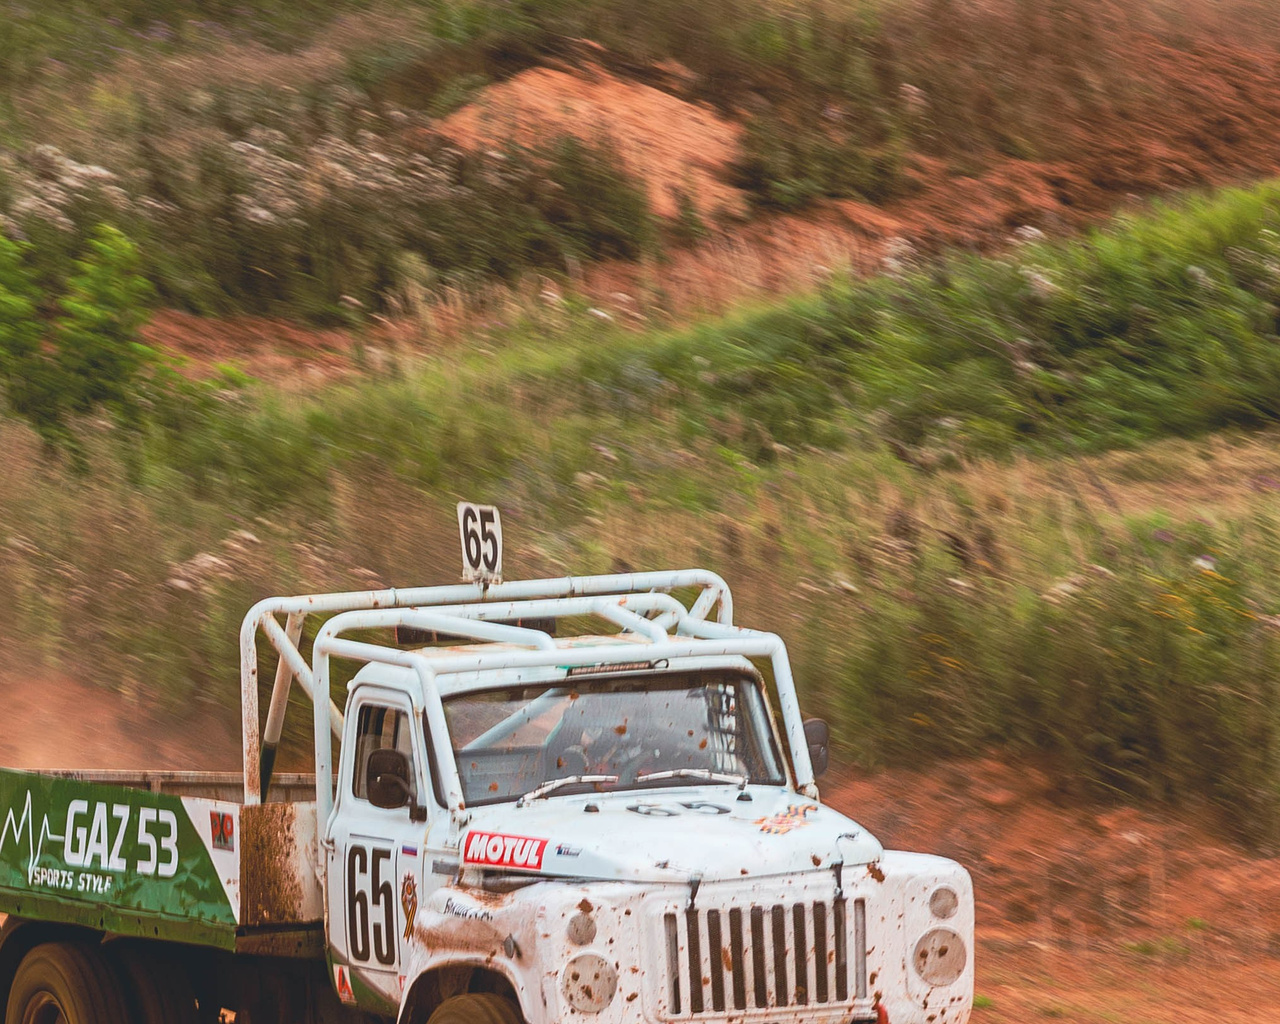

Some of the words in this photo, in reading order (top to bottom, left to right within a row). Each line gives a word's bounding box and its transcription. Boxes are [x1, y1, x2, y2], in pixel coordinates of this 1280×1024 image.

[463, 506, 498, 573] 65
[64, 799, 130, 872] GAZ
[137, 806, 179, 878] 53
[467, 833, 541, 867] MOTUL
[34, 866, 74, 890] SPORTS
[347, 844, 395, 965] 65
